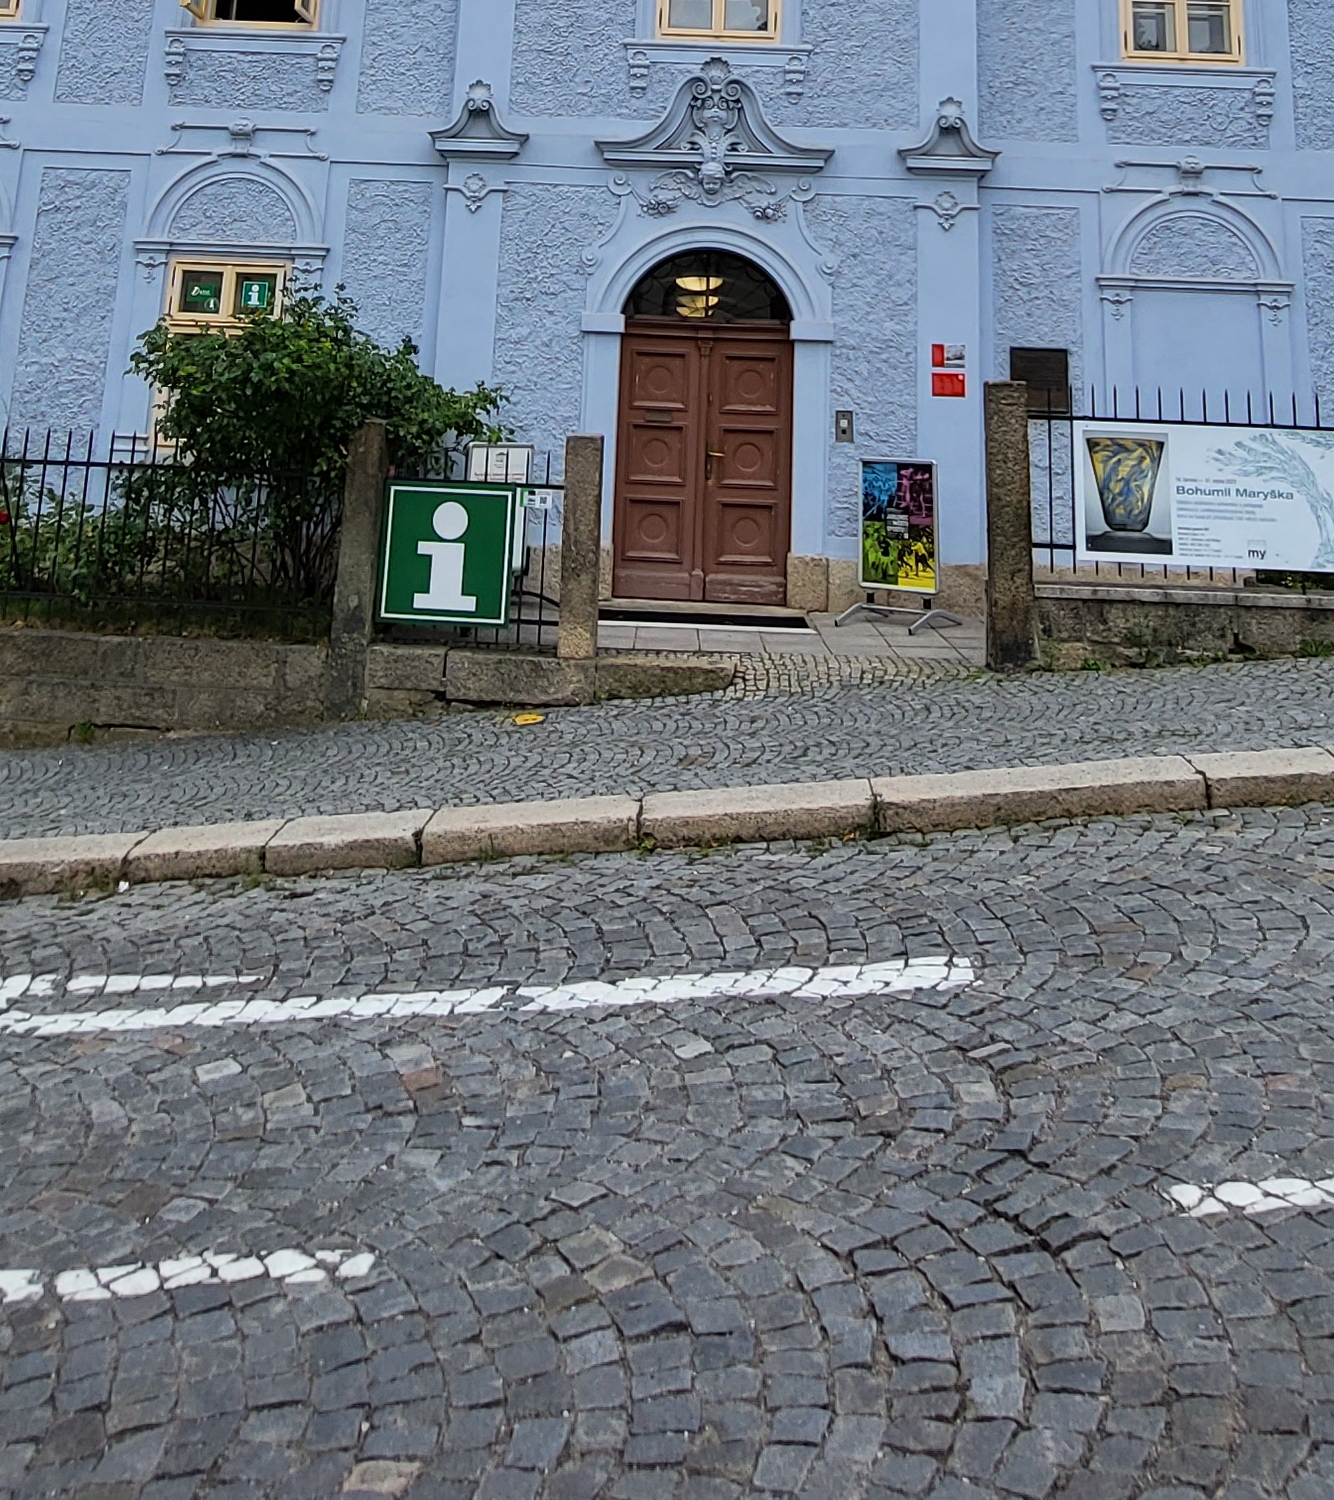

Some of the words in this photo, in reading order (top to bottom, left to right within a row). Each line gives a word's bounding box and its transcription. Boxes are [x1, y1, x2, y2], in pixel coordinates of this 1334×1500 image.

[1175, 485, 1231, 498] Bohumil
[1235, 487, 1294, 501] Maryška
[413, 501, 477, 612] i
[1248, 549, 1266, 560] my
